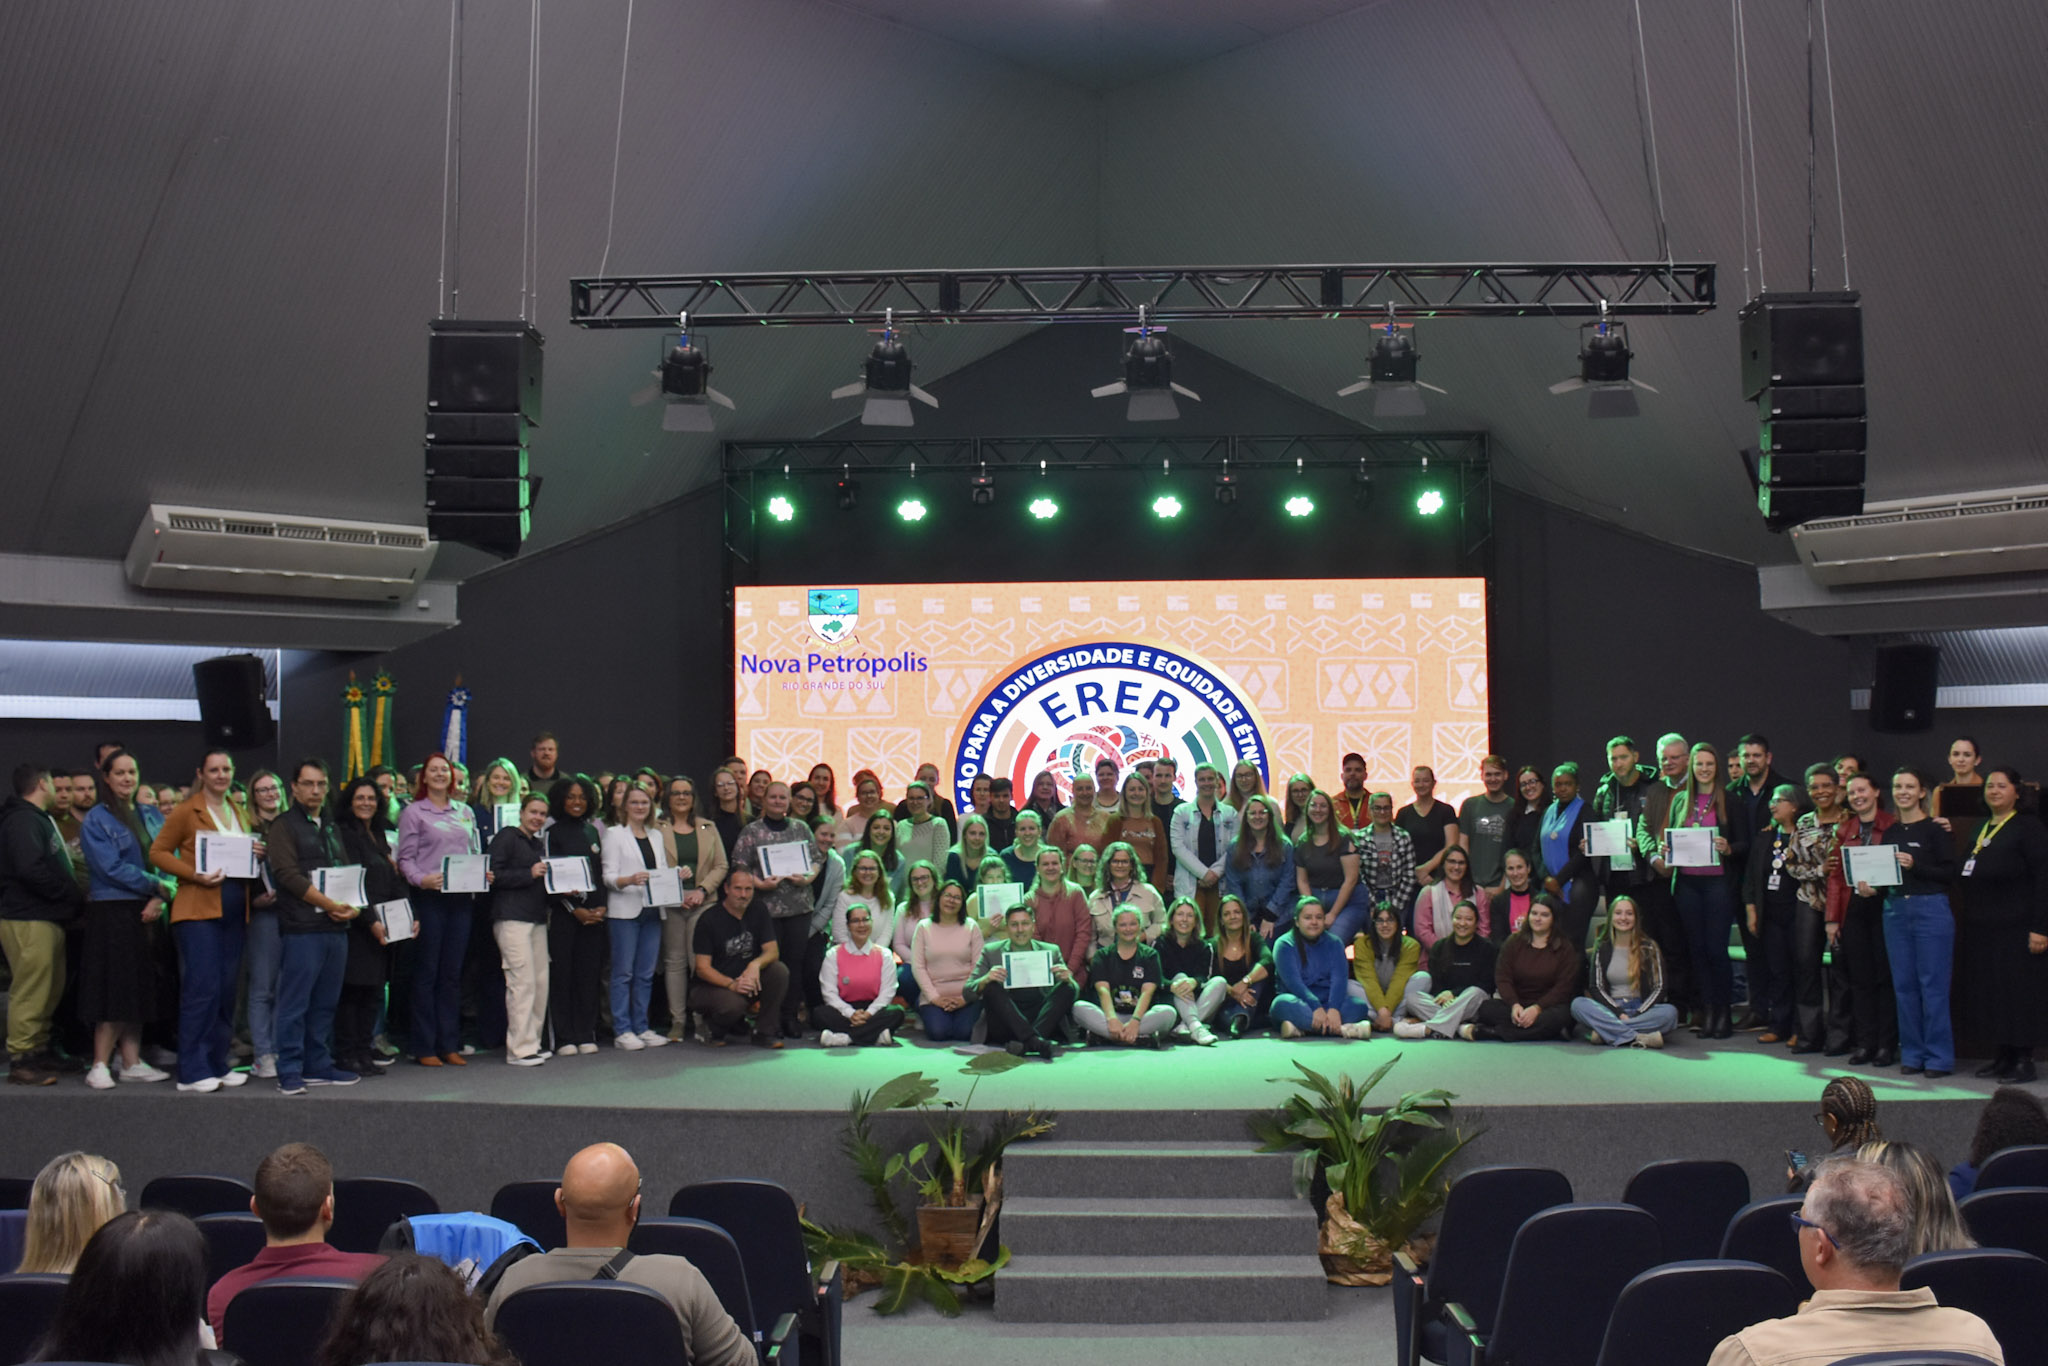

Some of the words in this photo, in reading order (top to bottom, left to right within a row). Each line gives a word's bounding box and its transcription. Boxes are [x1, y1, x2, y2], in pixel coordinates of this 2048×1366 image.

[741, 654, 800, 674] Nova
[807, 651, 928, 677] Petrópolis
[782, 682, 798, 690] RIO
[803, 681, 845, 690] GRANDE
[848, 681, 863, 690] DO
[867, 681, 885, 690] SUL
[964, 713, 998, 760] PARA
[991, 698, 1009, 714] A
[1003, 648, 1134, 701] DIVERSIDADE
[1137, 651, 1151, 667] E
[1153, 655, 1243, 725] EQUIDADE
[1038, 680, 1180, 729] ERER
